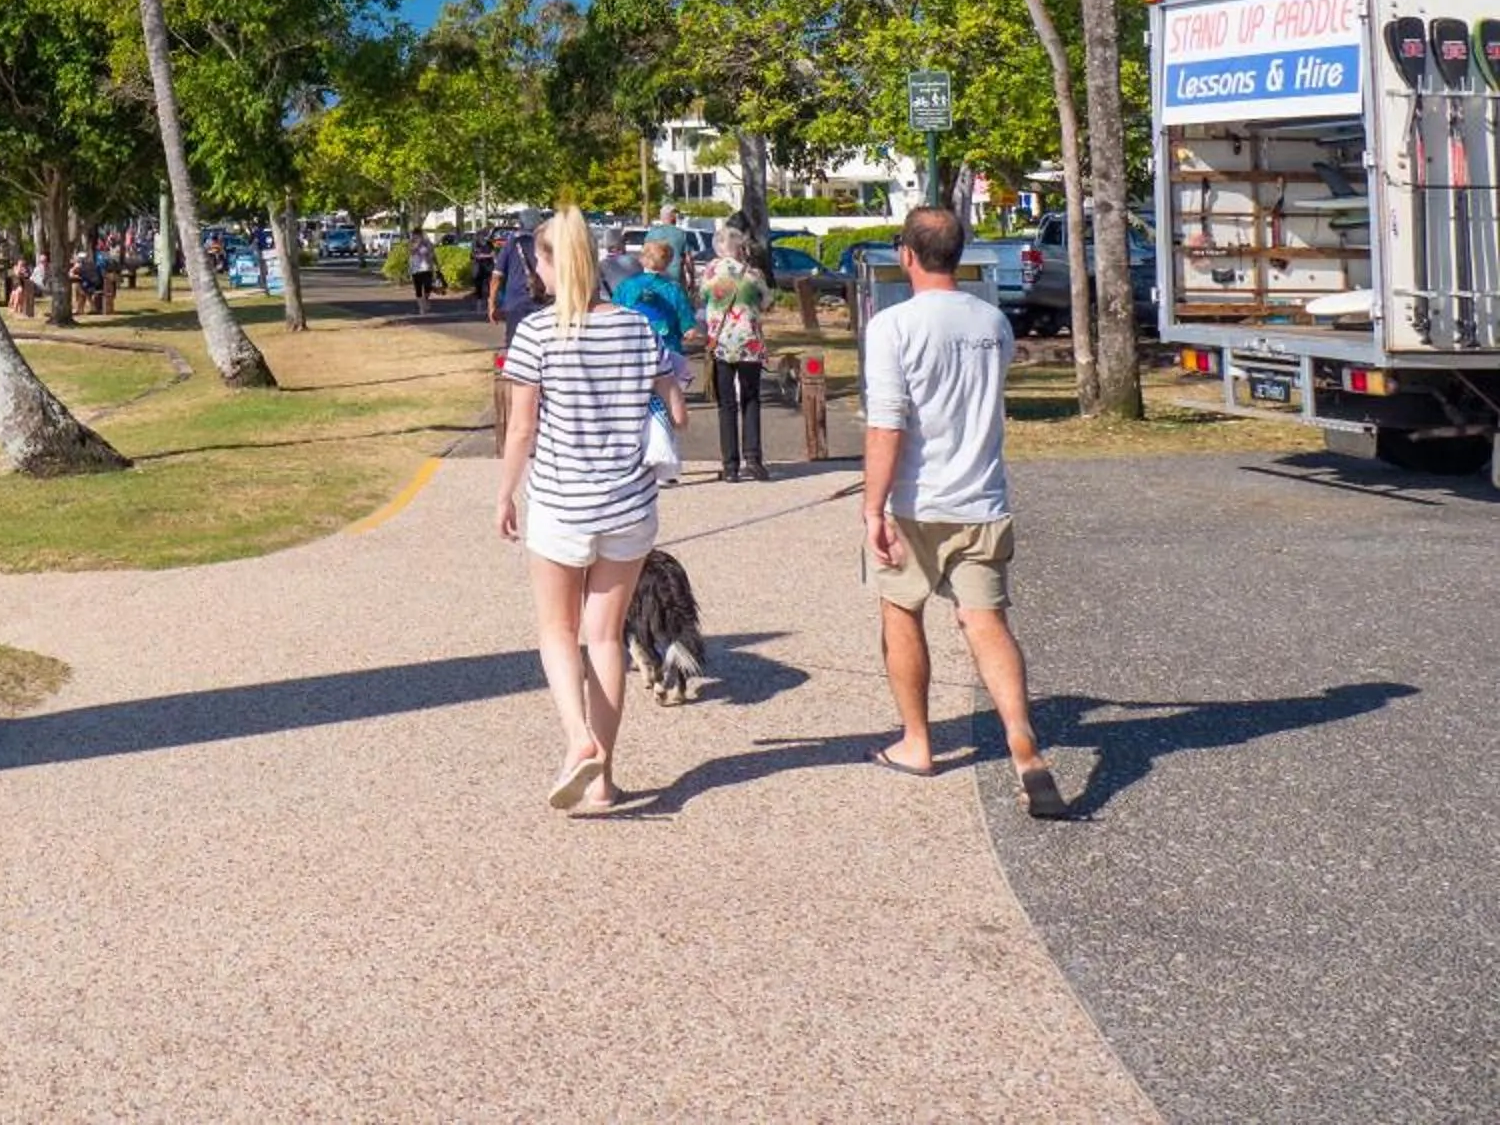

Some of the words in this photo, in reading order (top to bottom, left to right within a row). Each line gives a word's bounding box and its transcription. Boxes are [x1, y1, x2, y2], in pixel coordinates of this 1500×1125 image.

[1170, 9, 1229, 54] STAND
[1237, 4, 1265, 45] UP
[1176, 68, 1257, 100] Lessons
[1265, 58, 1285, 92] &
[1294, 55, 1344, 90] Hire
